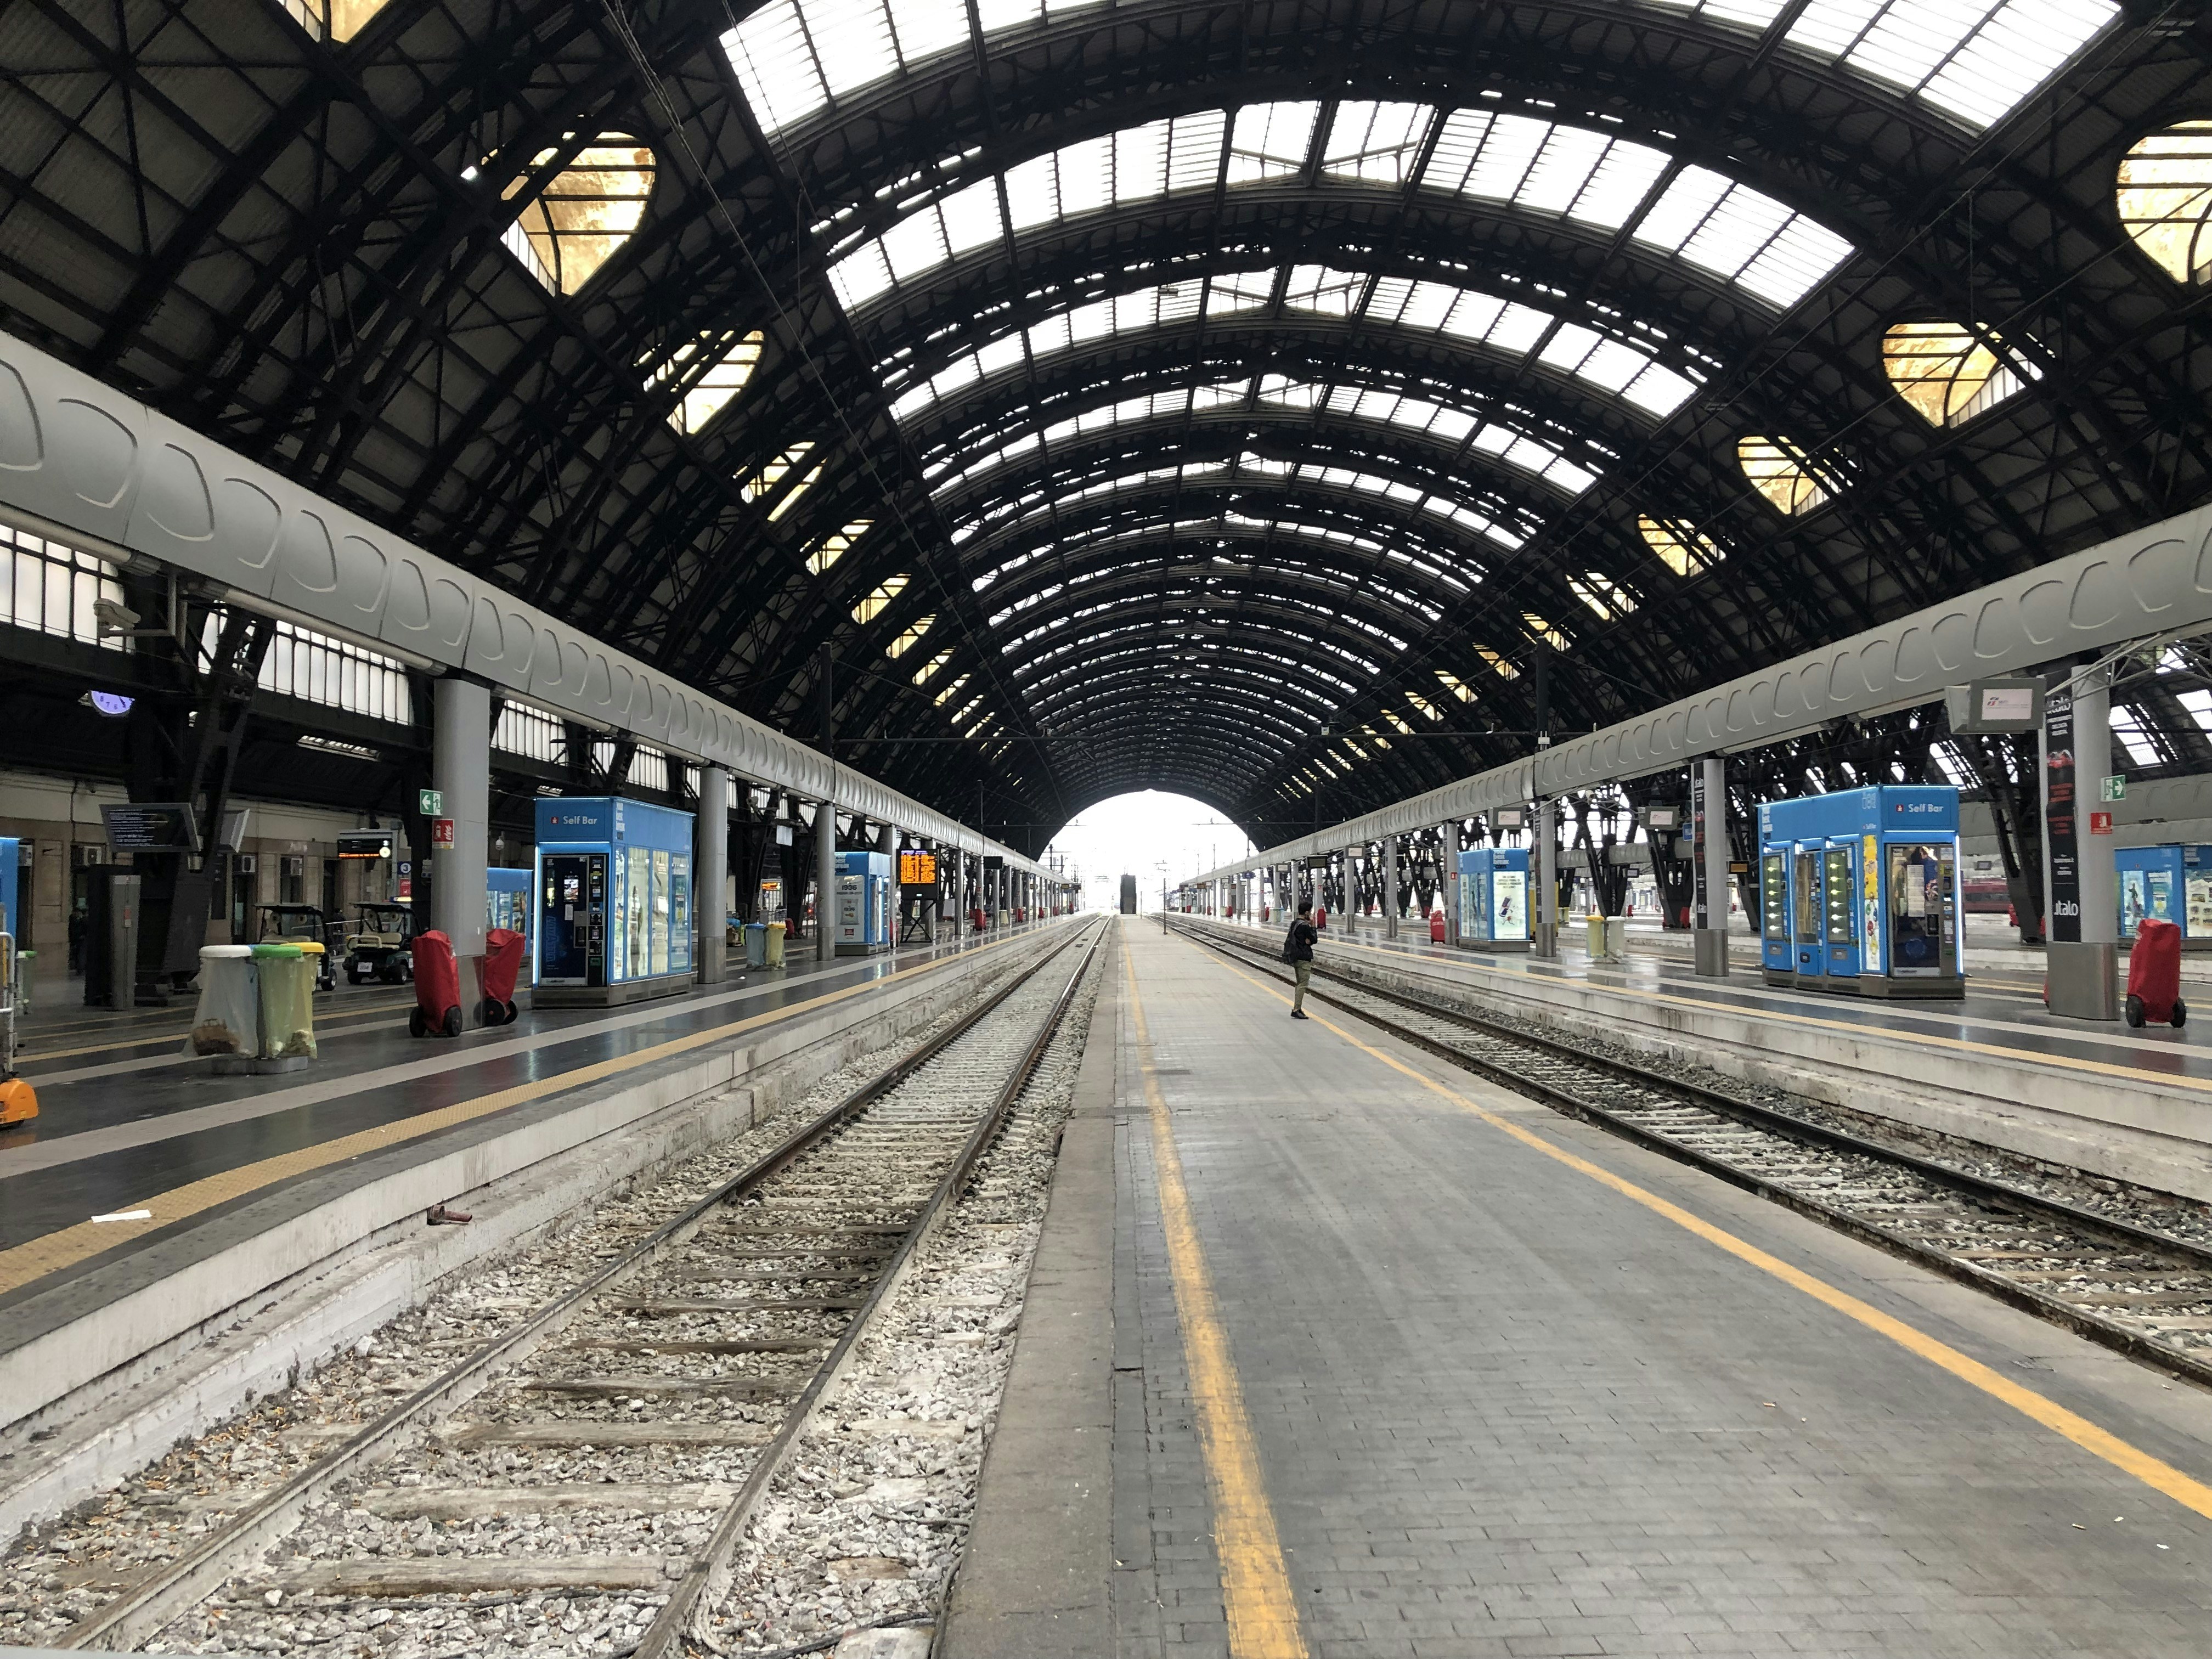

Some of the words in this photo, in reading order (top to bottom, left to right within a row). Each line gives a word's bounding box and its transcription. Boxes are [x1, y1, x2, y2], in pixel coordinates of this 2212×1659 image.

[1908, 803, 1926, 812] Self
[1928, 804, 1944, 812] Bar
[563, 816, 580, 825] Self
[582, 816, 598, 825] Bar
